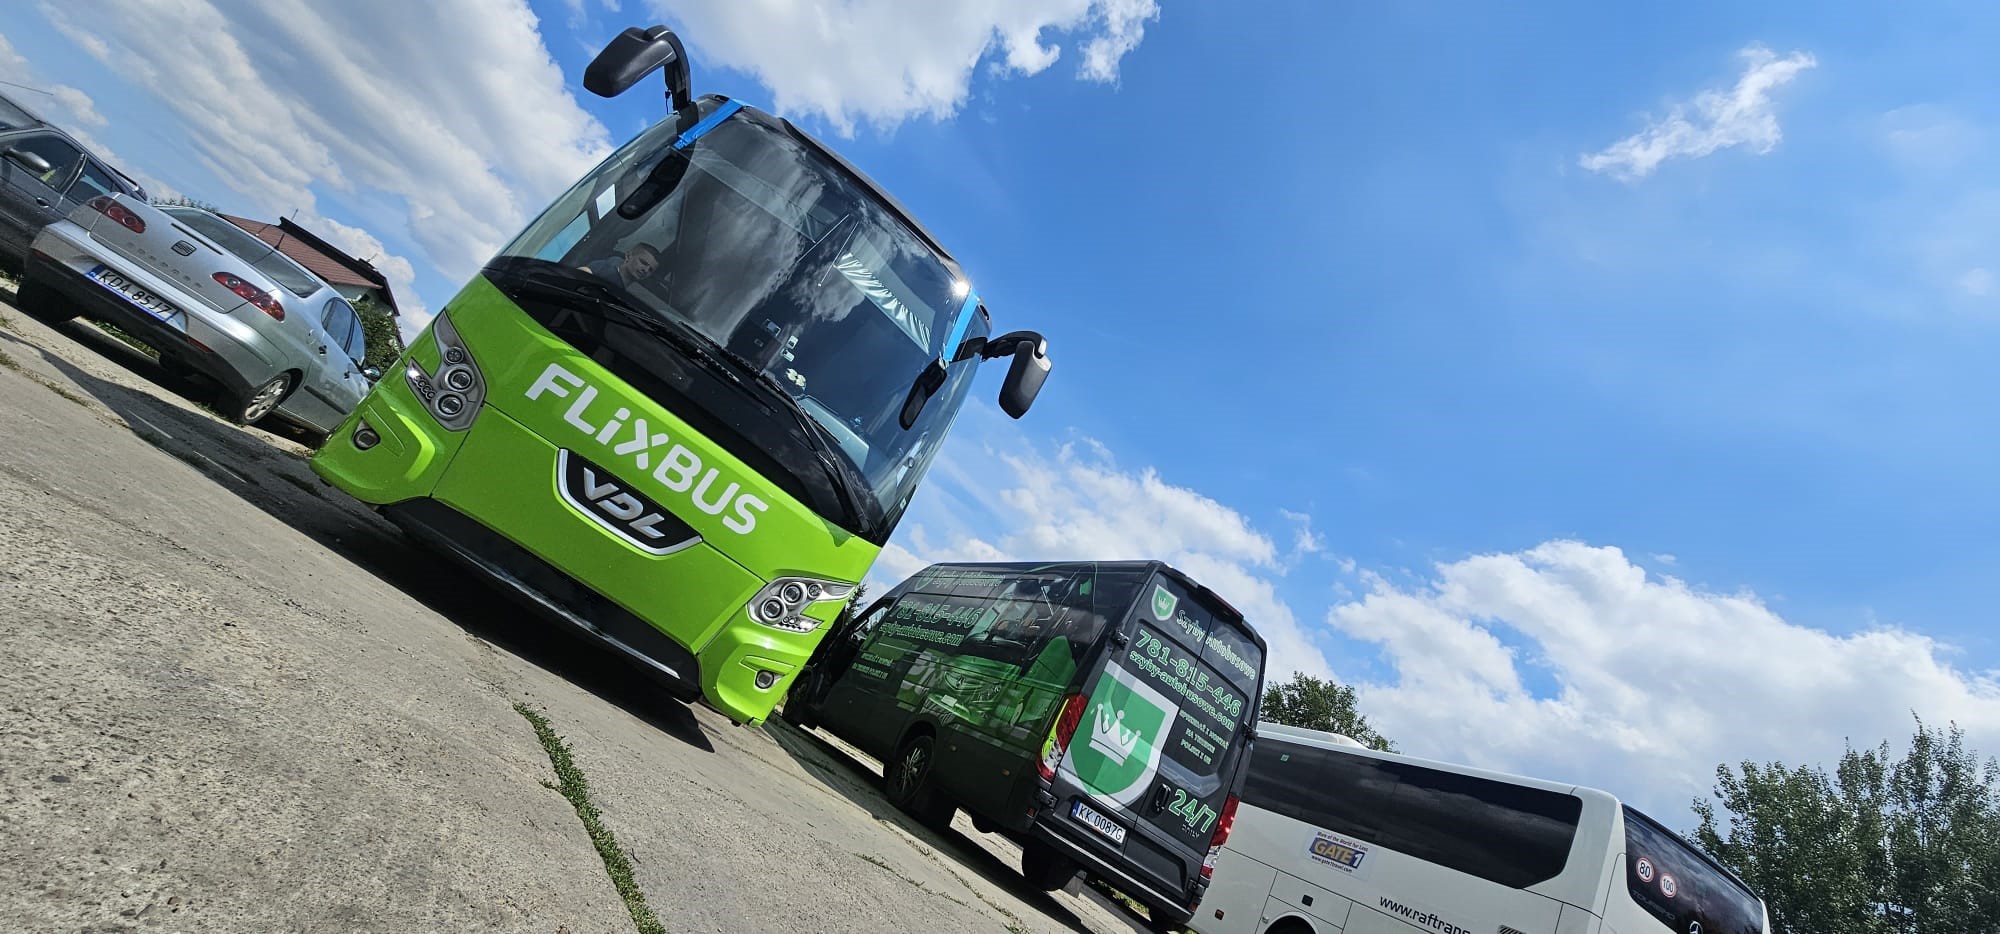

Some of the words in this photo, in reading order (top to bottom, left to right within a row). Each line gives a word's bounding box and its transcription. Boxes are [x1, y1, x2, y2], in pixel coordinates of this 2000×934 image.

[99, 271, 129, 294] KDA
[131, 290, 173, 315] 85J7
[583, 467, 666, 539] VDL
[1129, 650, 1235, 732] szyby-autobusowe.com
[1135, 629, 1241, 717] 781-815-446
[1078, 805, 1093, 822] KK
[1094, 815, 1123, 840] 0087G
[1168, 788, 1217, 833] 24/7
[1640, 862, 1651, 878] 80
[1663, 878, 1674, 893] 100
